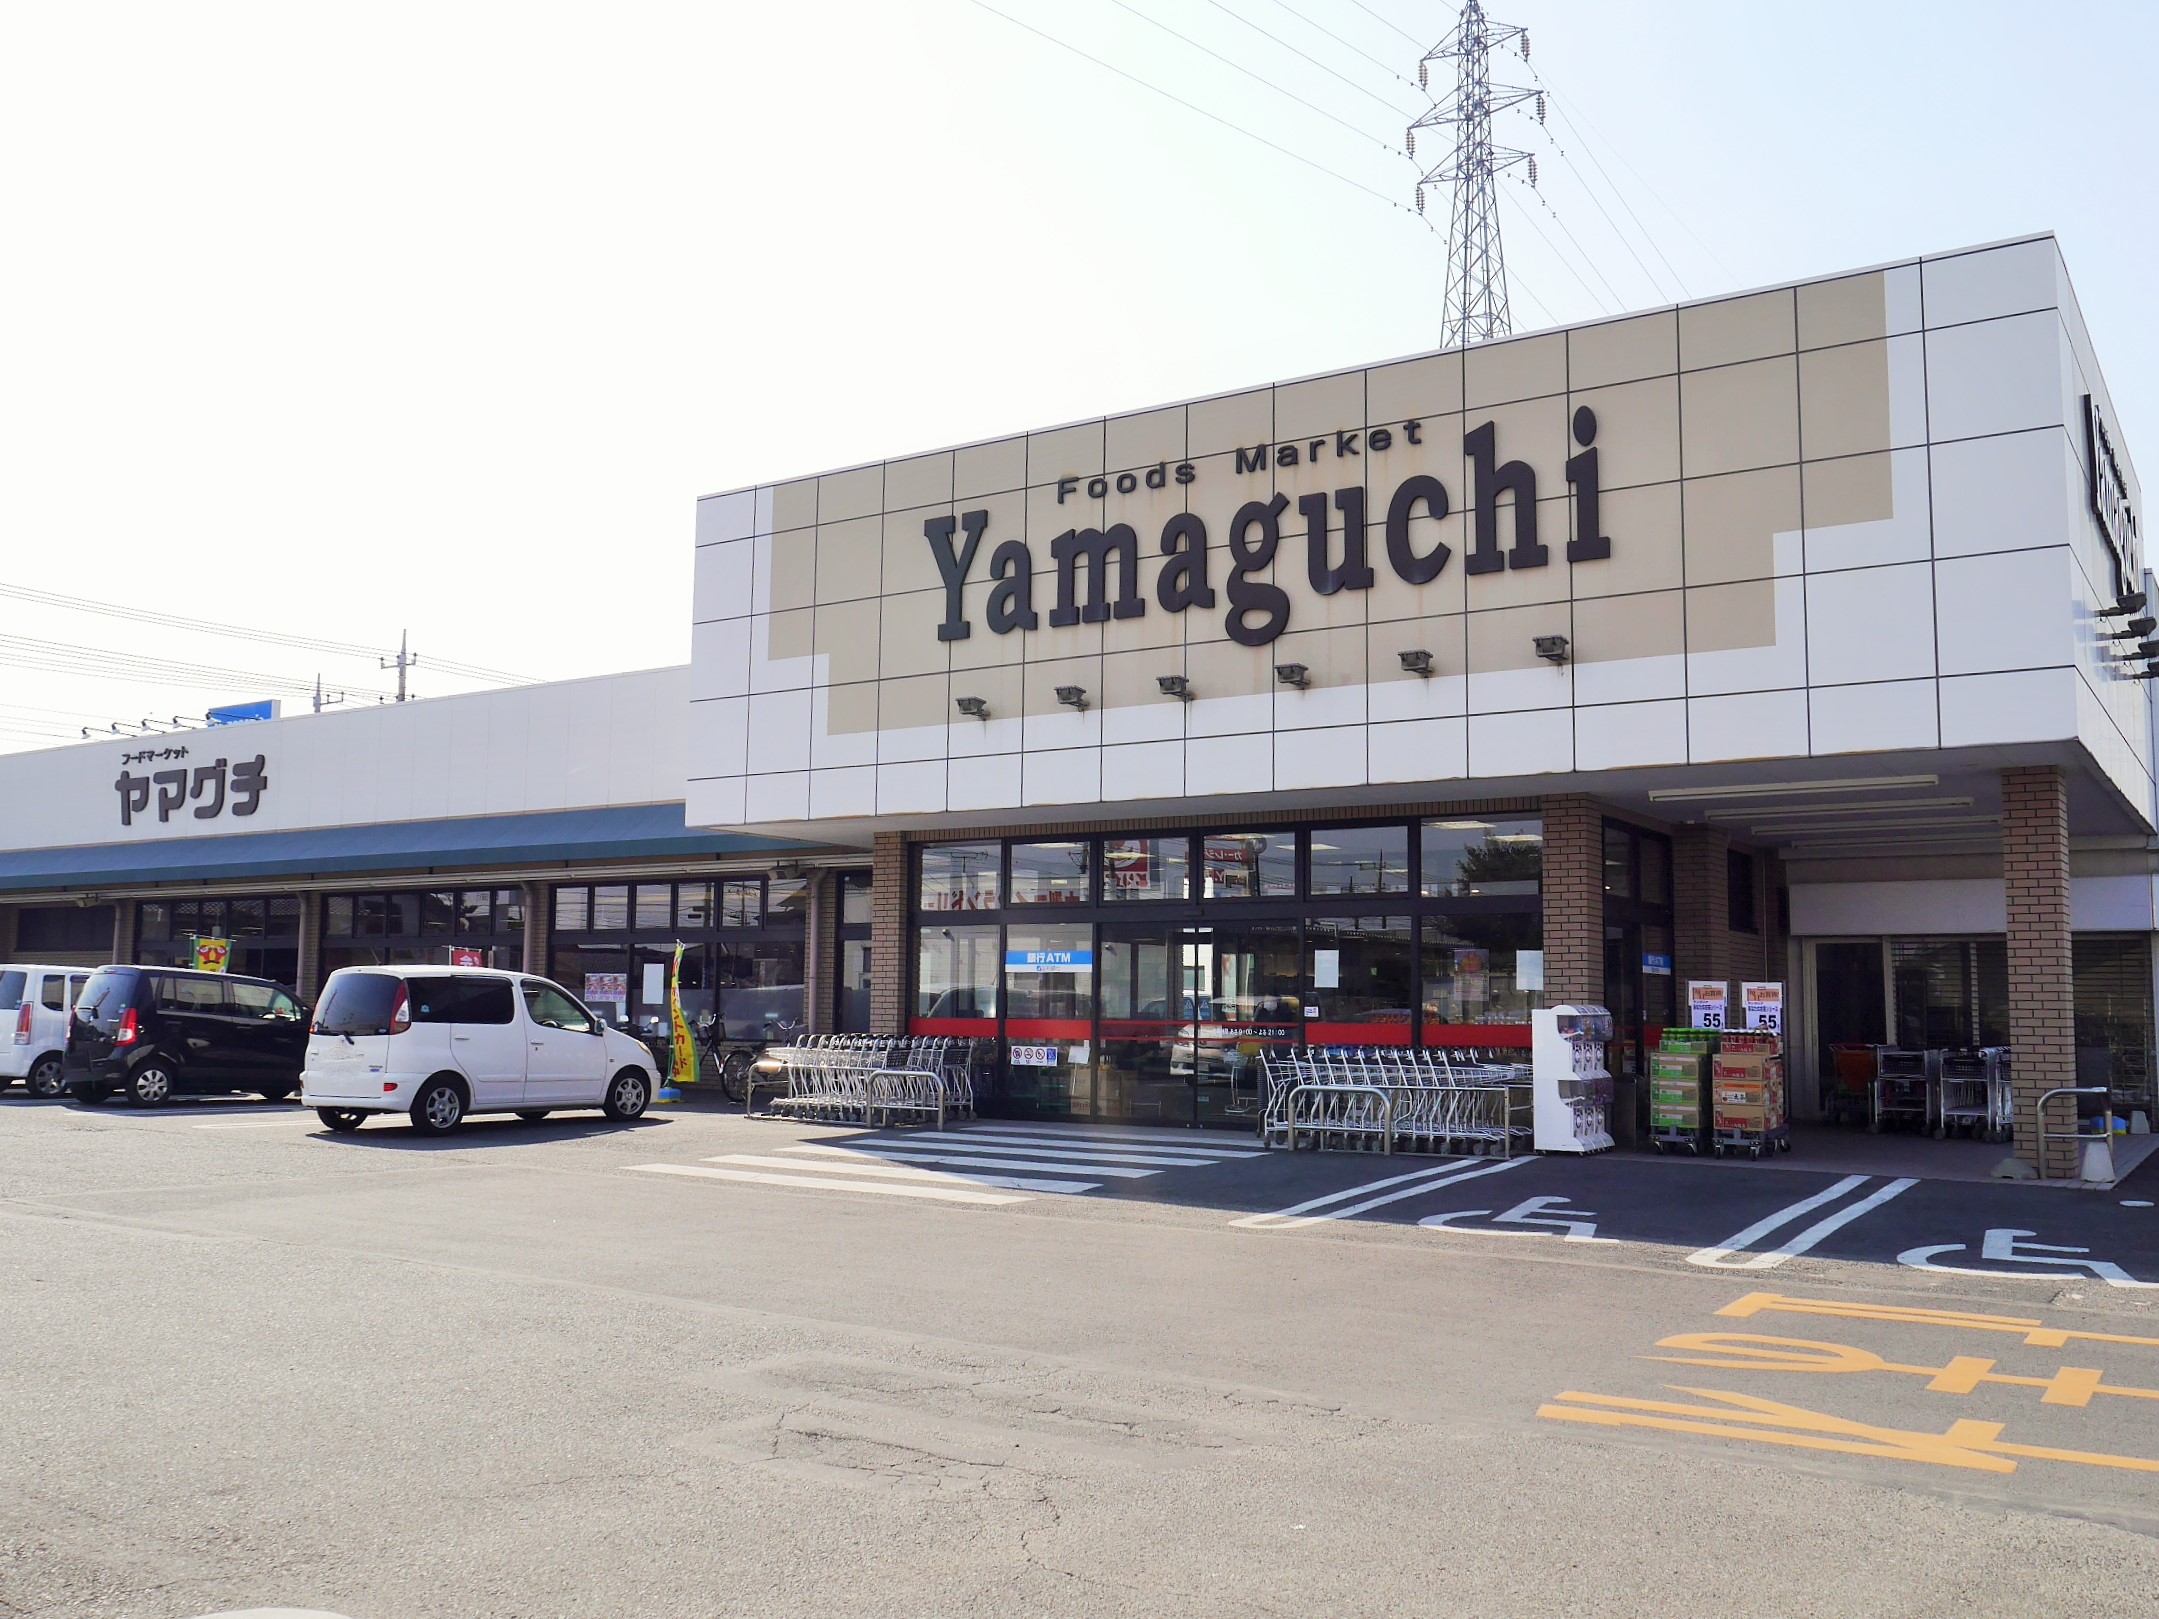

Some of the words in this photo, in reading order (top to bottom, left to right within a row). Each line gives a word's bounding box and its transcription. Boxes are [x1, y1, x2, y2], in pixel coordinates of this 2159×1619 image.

[1056, 459, 1197, 504] Foods
[1234, 417, 1423, 475] Market
[923, 405, 1612, 647] Yamaguchi
[121, 746, 189, 765] フードマーケット
[114, 753, 268, 826] ヤマグチ
[1026, 952, 1072, 963] 銀行ATM
[1703, 1012, 1721, 1028] 55
[1758, 1014, 1777, 1030] 55
